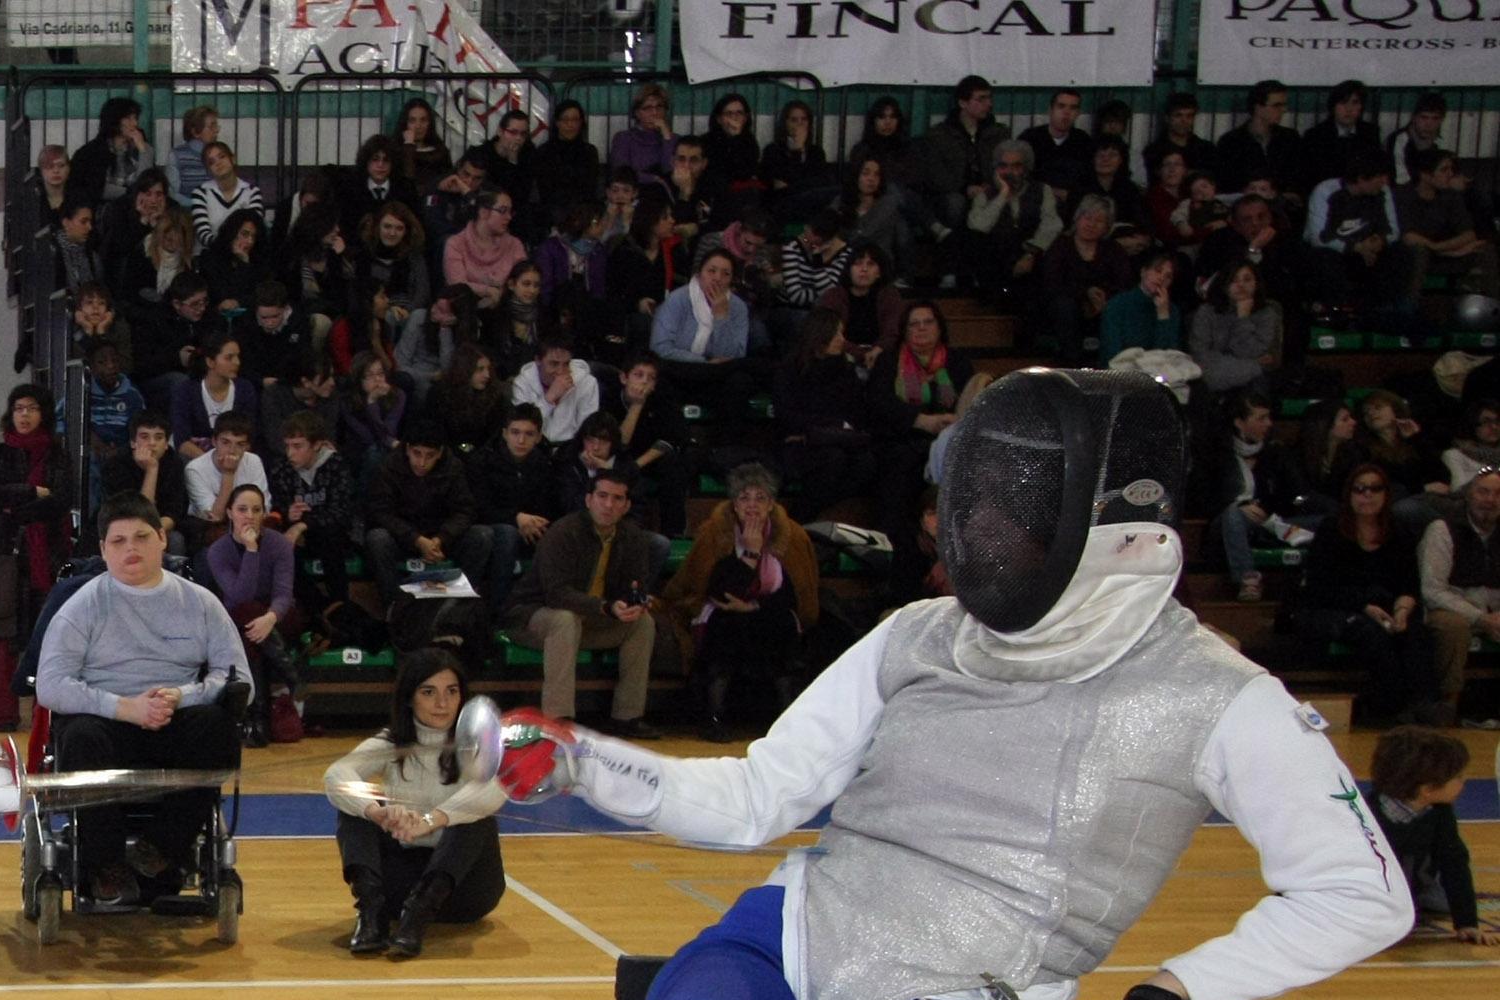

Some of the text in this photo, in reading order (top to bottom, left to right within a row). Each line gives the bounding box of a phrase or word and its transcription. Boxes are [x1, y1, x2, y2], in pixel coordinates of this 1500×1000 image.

[1224, 0, 1500, 30] PAQU
[19, 22, 40, 35] Via
[1248, 36, 1456, 50] CENTERGROSS
[1483, 37, 1500, 50] B
